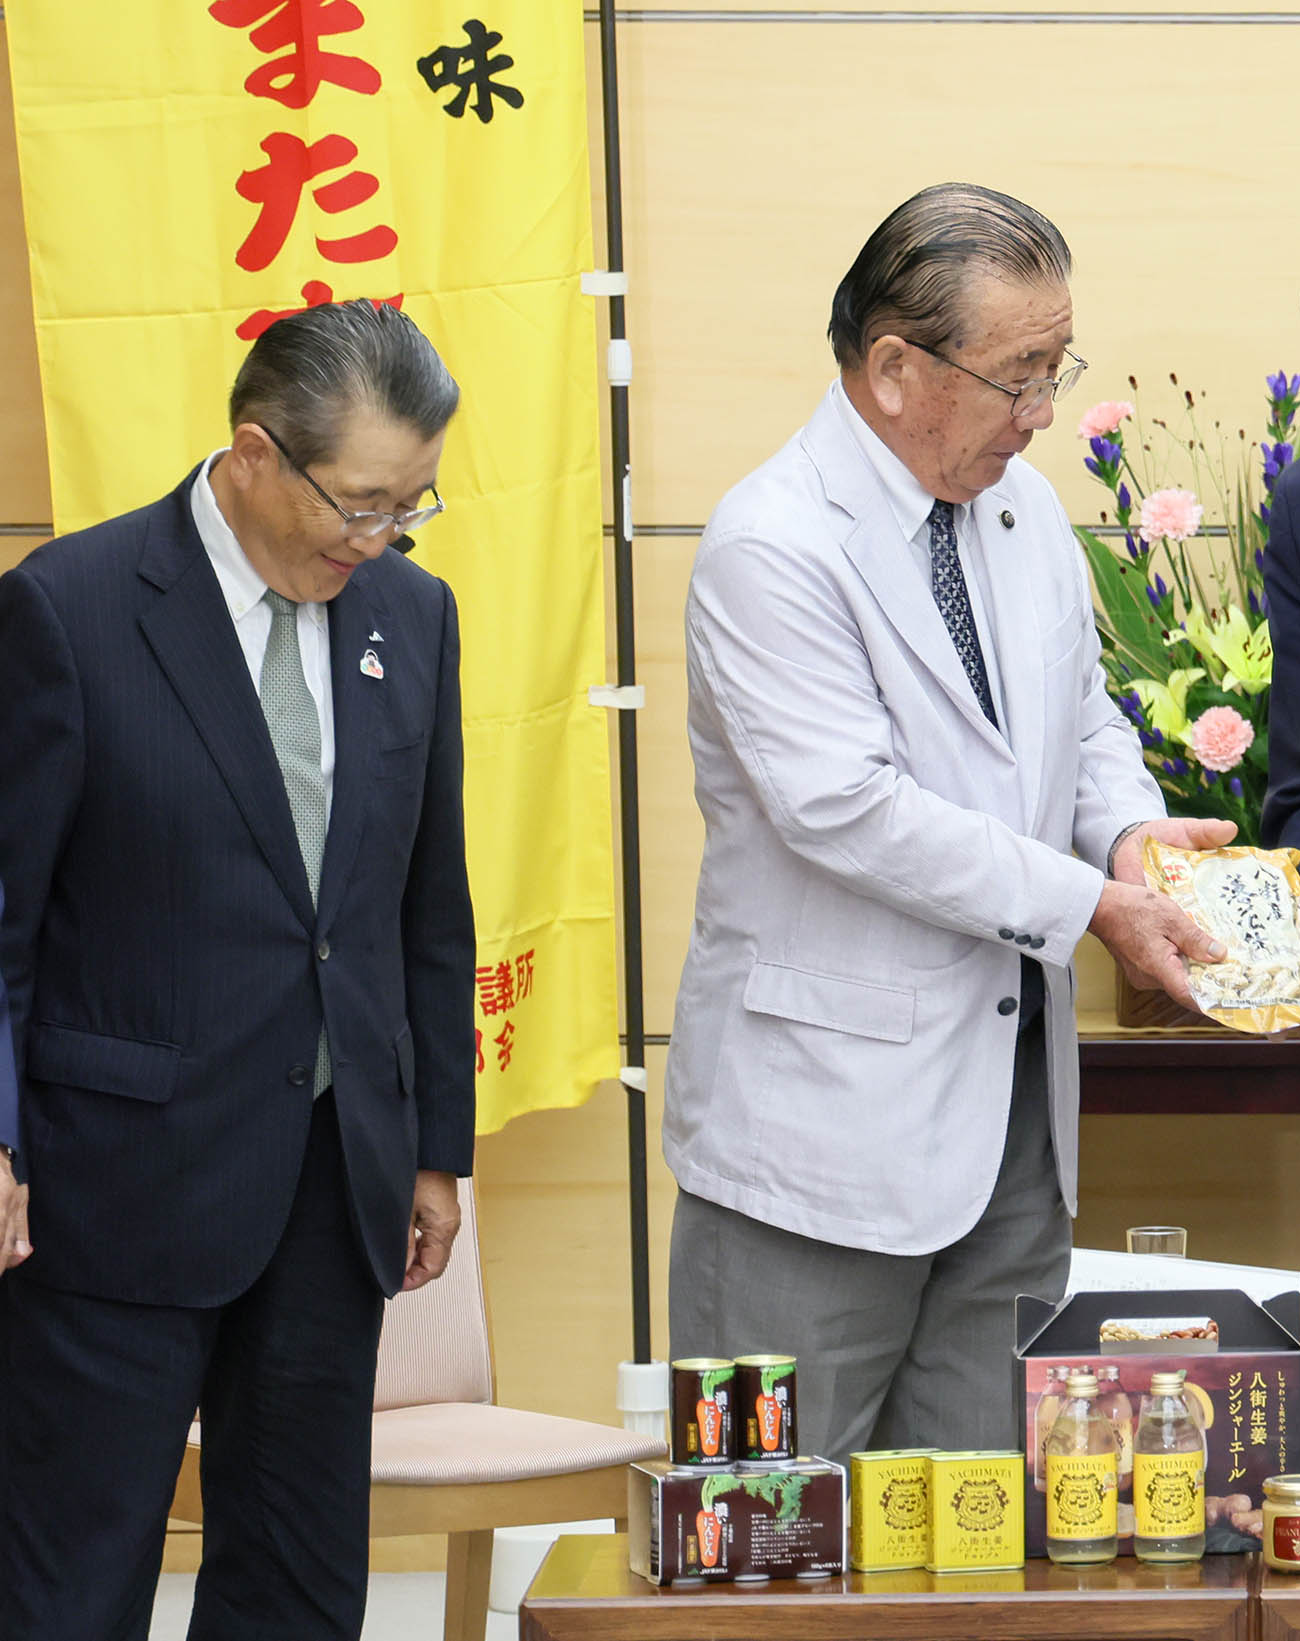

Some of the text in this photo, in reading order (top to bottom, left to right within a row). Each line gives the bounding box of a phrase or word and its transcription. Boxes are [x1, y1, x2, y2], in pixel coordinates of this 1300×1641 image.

[417, 19, 524, 124] 味
[208, 0, 404, 342] また
[1228, 1371, 1246, 1483] ジンジャーエール
[1249, 1371, 1268, 1446] 八街生姜
[949, 1468, 1013, 1481] YACHIMATA
[703, 1516, 715, 1557] にんじん
